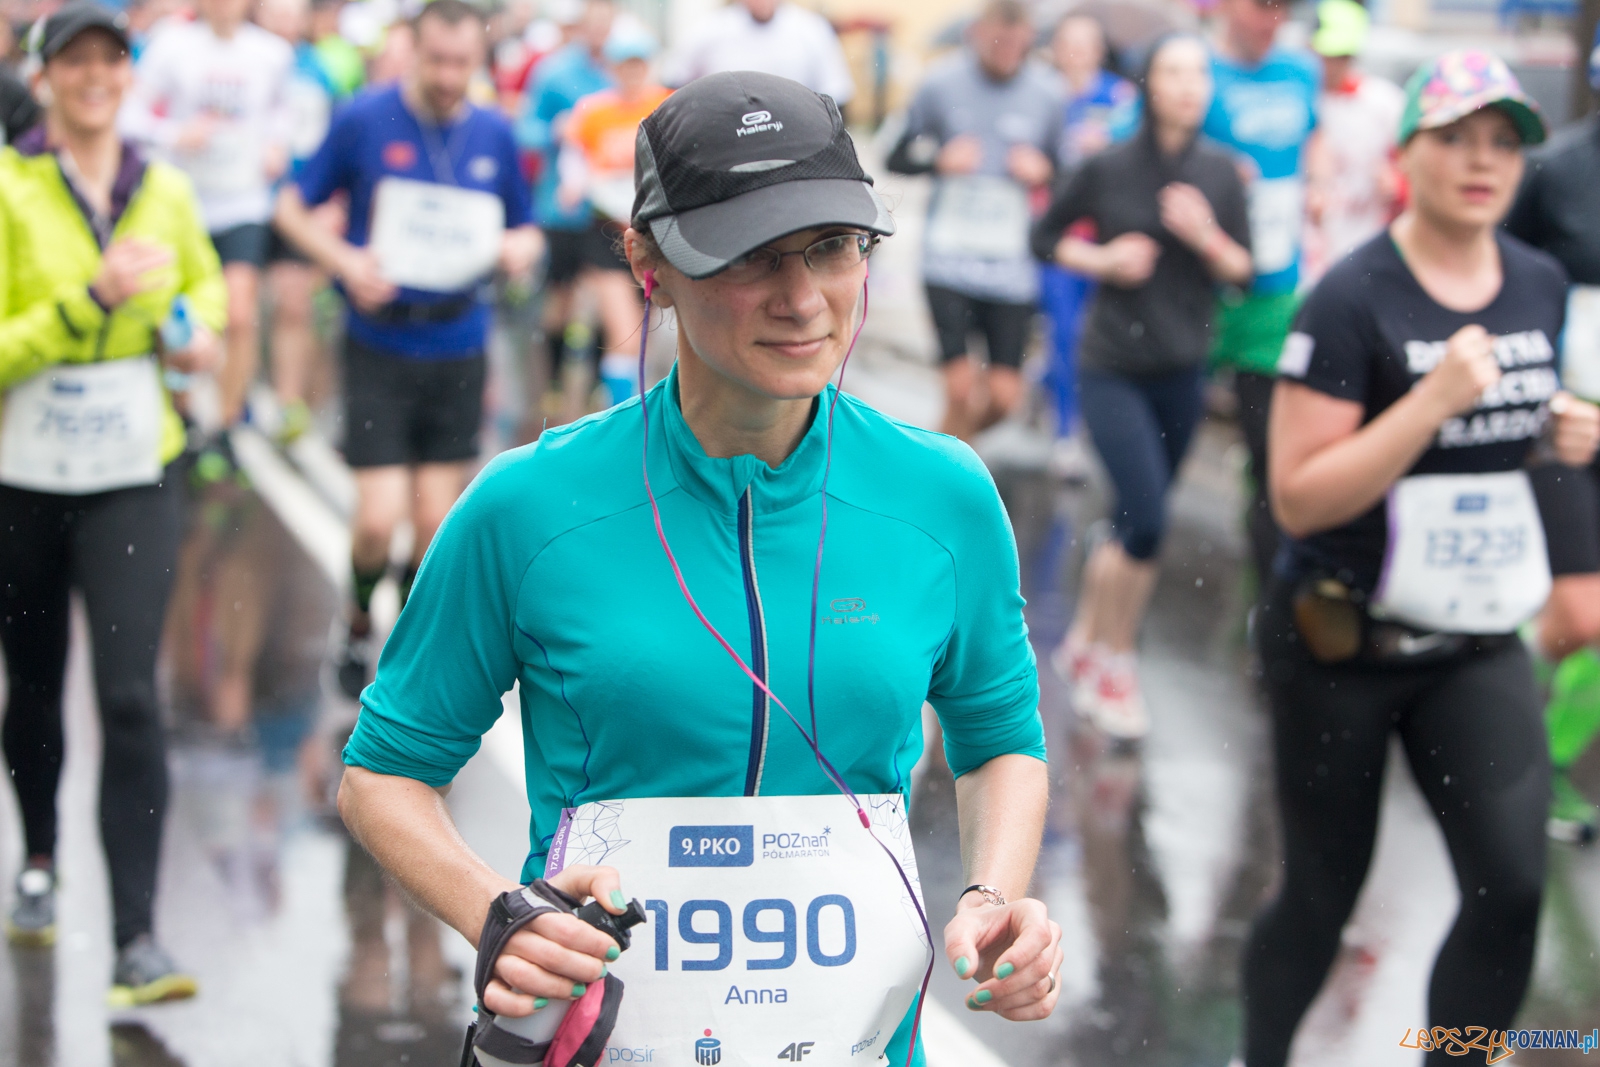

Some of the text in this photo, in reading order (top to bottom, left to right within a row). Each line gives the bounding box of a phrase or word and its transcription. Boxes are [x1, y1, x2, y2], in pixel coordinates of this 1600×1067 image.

[736, 120, 783, 137] Kalenji
[821, 612, 880, 625] Kalenji
[550, 825, 567, 871] 17.04.2016
[699, 837, 741, 856] PKO
[762, 849, 830, 859] PÓŁMARATON
[645, 893, 857, 972] 1990
[724, 985, 788, 1005] Anna
[777, 1041, 815, 1062] 4F
